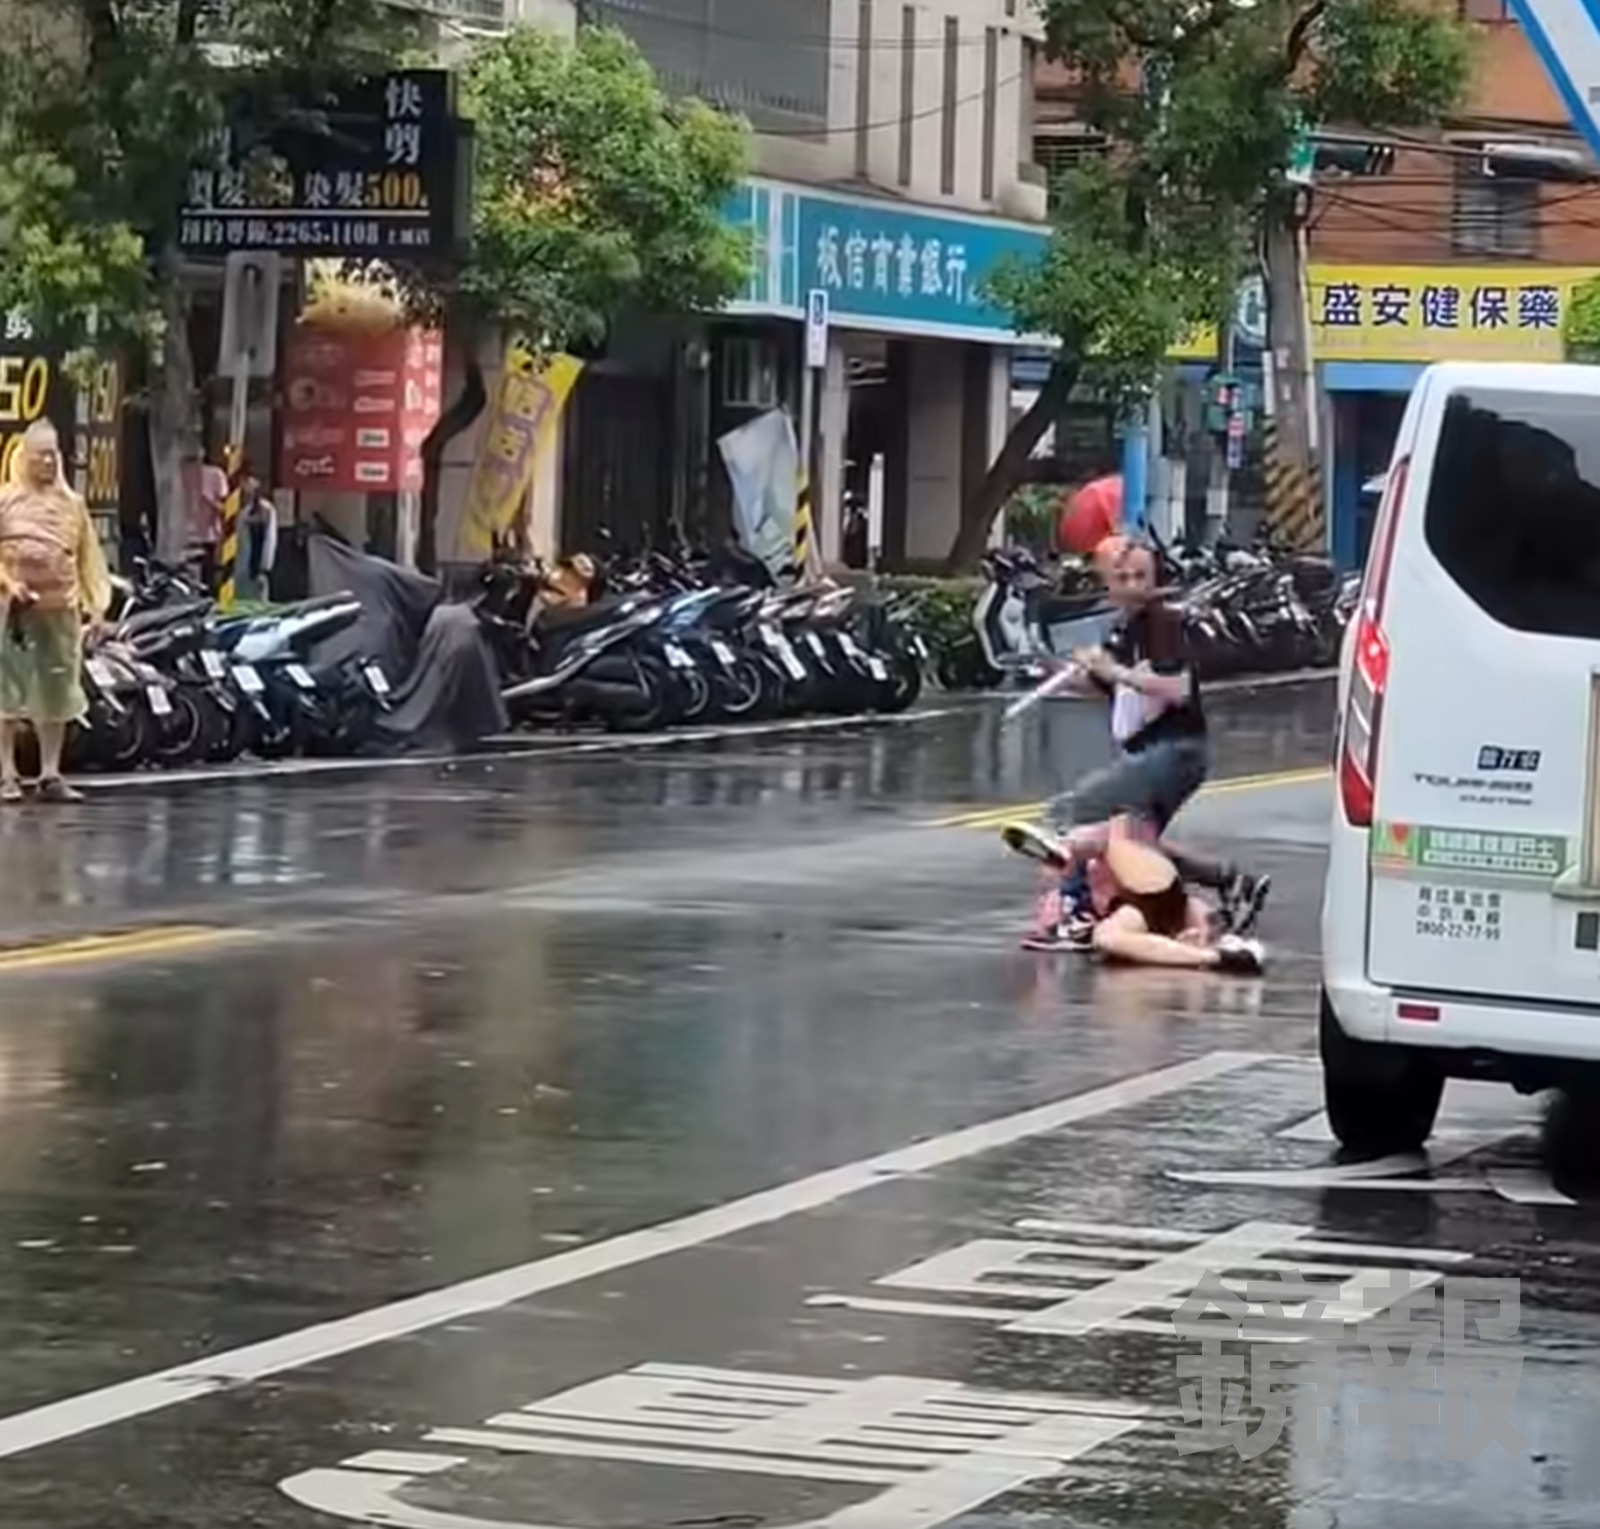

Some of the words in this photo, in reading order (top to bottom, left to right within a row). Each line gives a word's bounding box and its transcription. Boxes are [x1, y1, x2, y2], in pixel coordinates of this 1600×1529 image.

[385, 79, 421, 164] 快剪
[1322, 286, 1578, 330] 盛安健保藥
